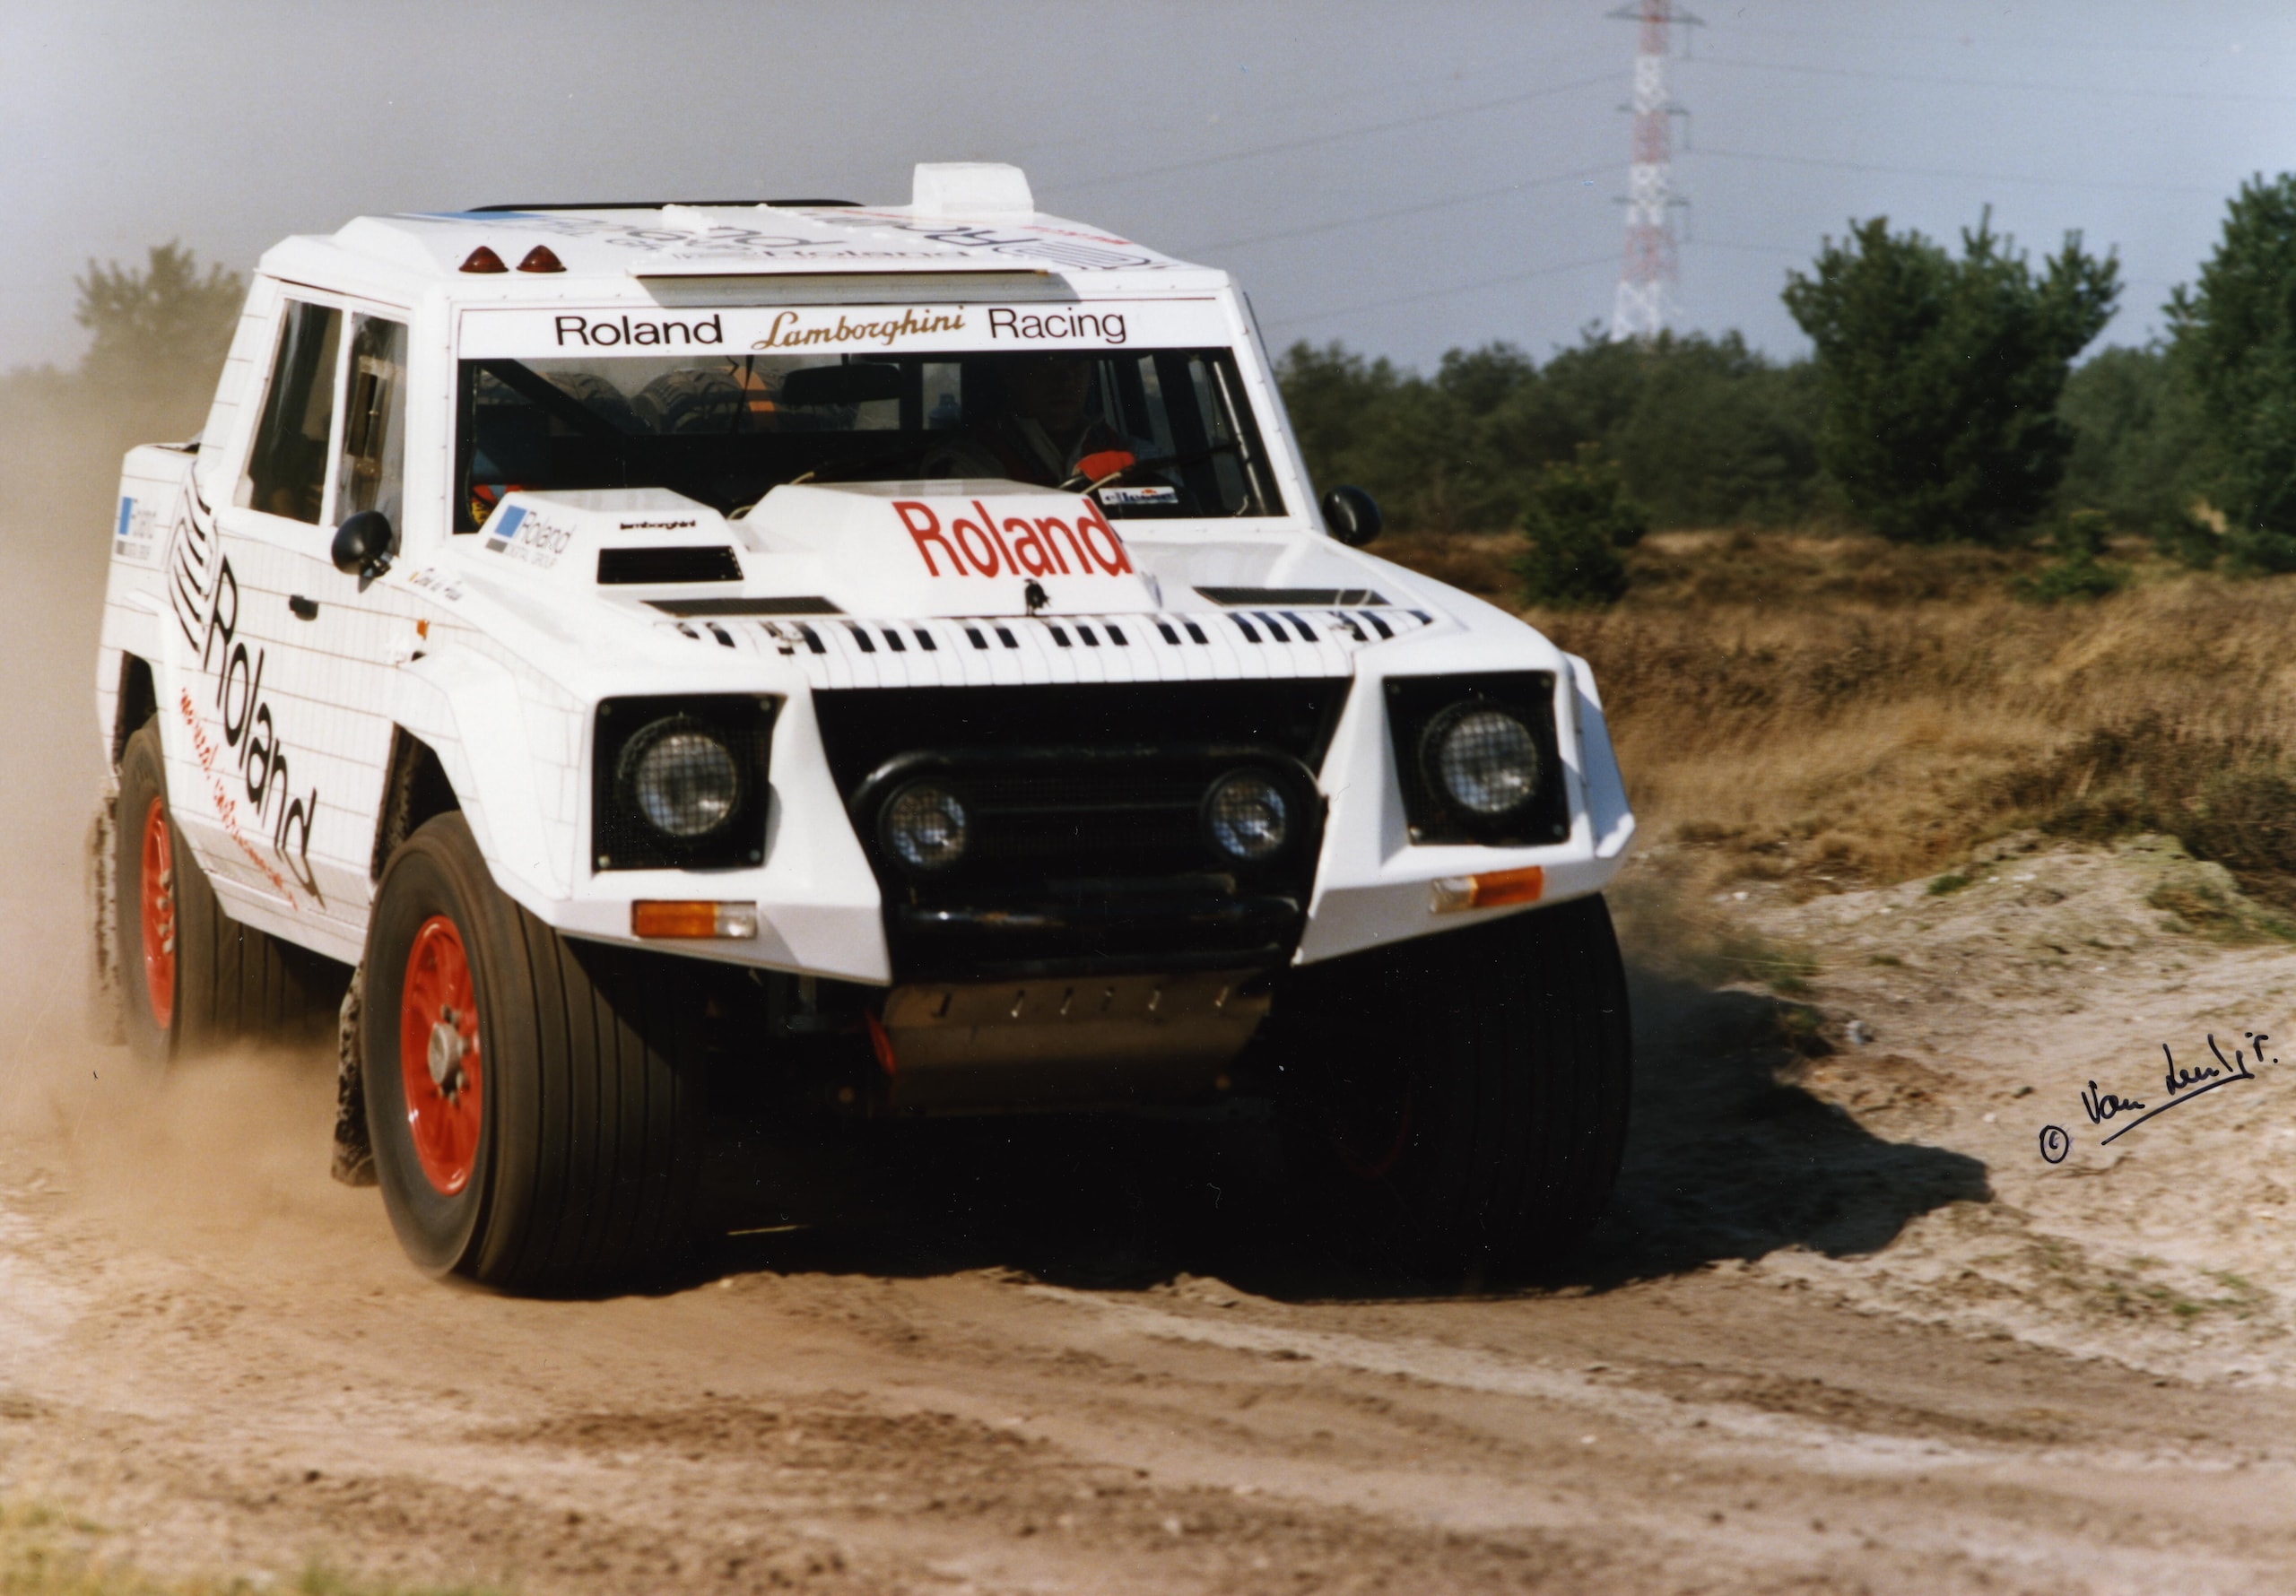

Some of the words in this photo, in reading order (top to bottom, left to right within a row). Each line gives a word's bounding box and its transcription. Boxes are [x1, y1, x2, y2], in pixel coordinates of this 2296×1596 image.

[554, 313, 724, 346] Roland
[751, 305, 966, 351] Lamborghini
[987, 307, 1126, 343] Racing
[516, 510, 578, 554] Roland
[891, 499, 1134, 578] Roland
[204, 552, 326, 909] Roland
